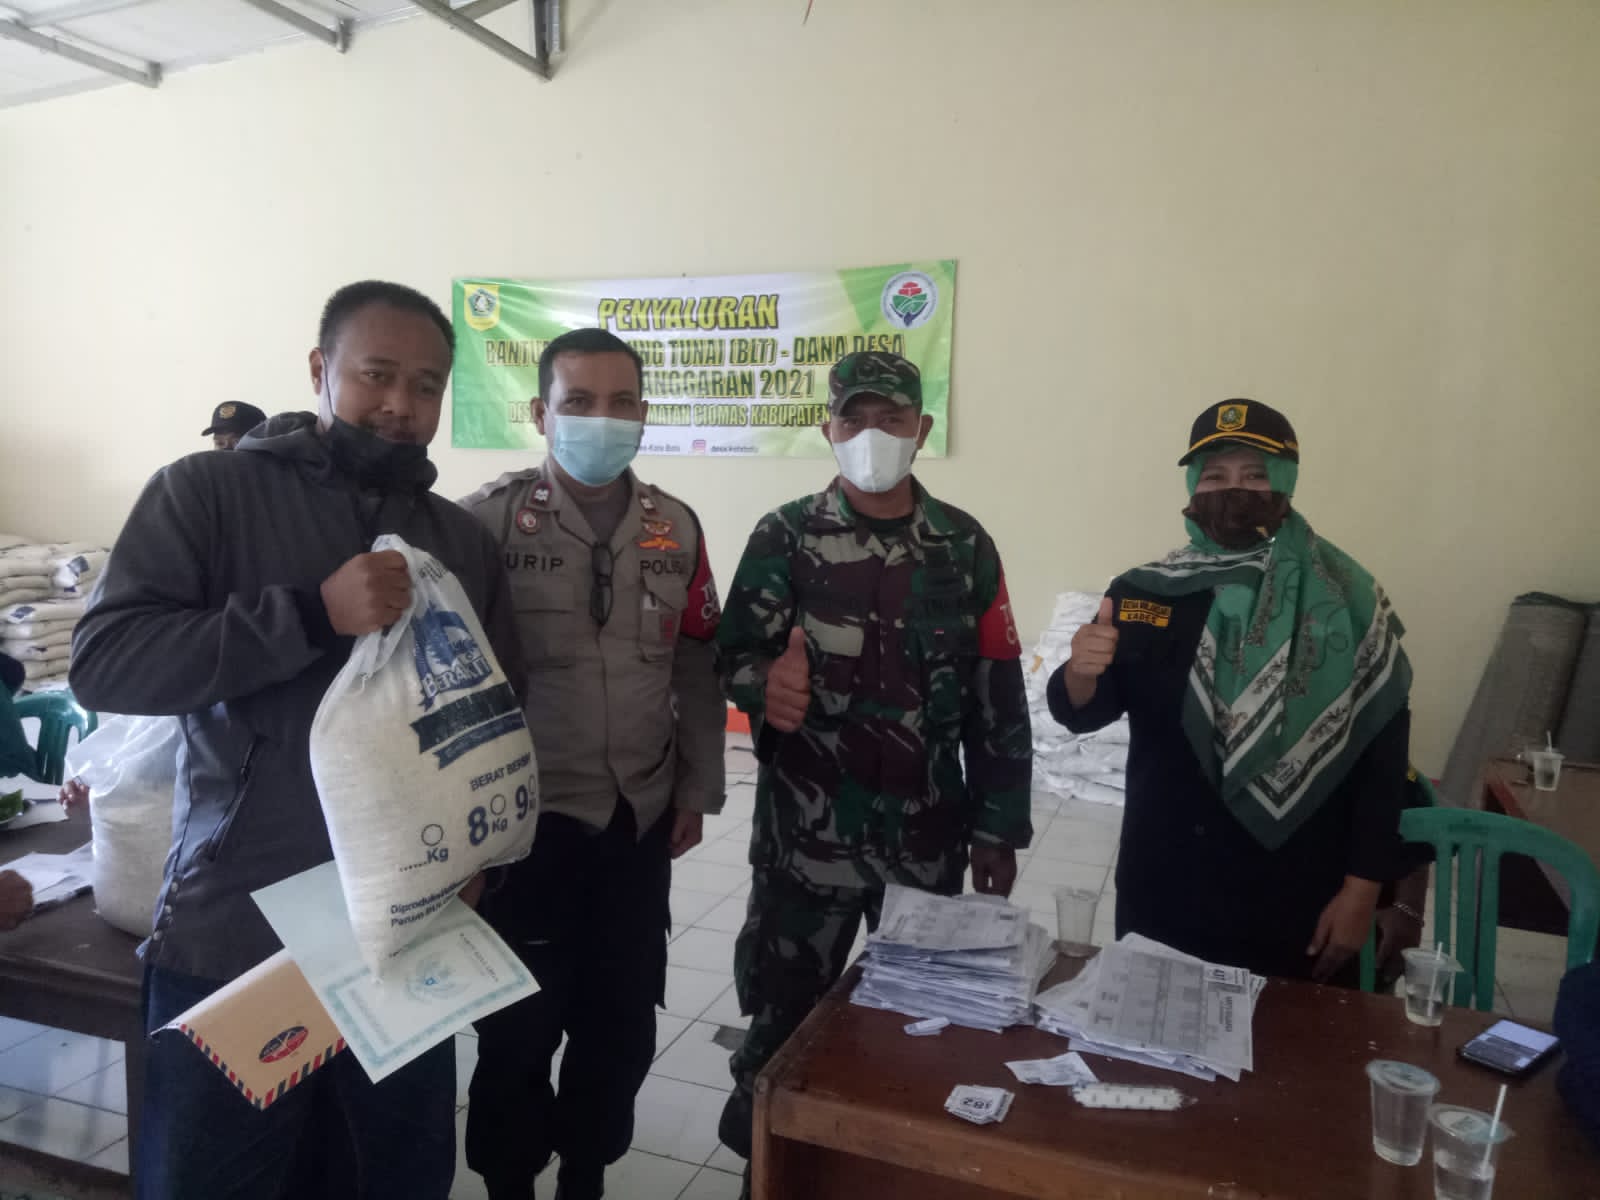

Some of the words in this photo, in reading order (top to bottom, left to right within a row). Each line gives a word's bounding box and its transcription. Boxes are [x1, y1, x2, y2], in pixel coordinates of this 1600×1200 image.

[598, 294, 780, 331] PENYALURAN
[485, 338, 550, 367] BANTU
[668, 338, 725, 367] TUNAI
[728, 337, 778, 367] (BLT)
[792, 334, 849, 366] DANA
[852, 333, 908, 356] DESA
[641, 369, 756, 398] ANGGARAN
[759, 368, 816, 399] 2021
[507, 400, 535, 424] DES
[645, 403, 691, 427] MATAN
[692, 403, 748, 428] CIOMAS
[750, 403, 831, 428] KABUPATEN
[506, 552, 564, 572] URIP
[639, 559, 689, 576] POLIS
[469, 768, 505, 792] BERAT
[515, 784, 530, 821] 9
[468, 806, 489, 847] 8
[492, 818, 509, 834] Kg
